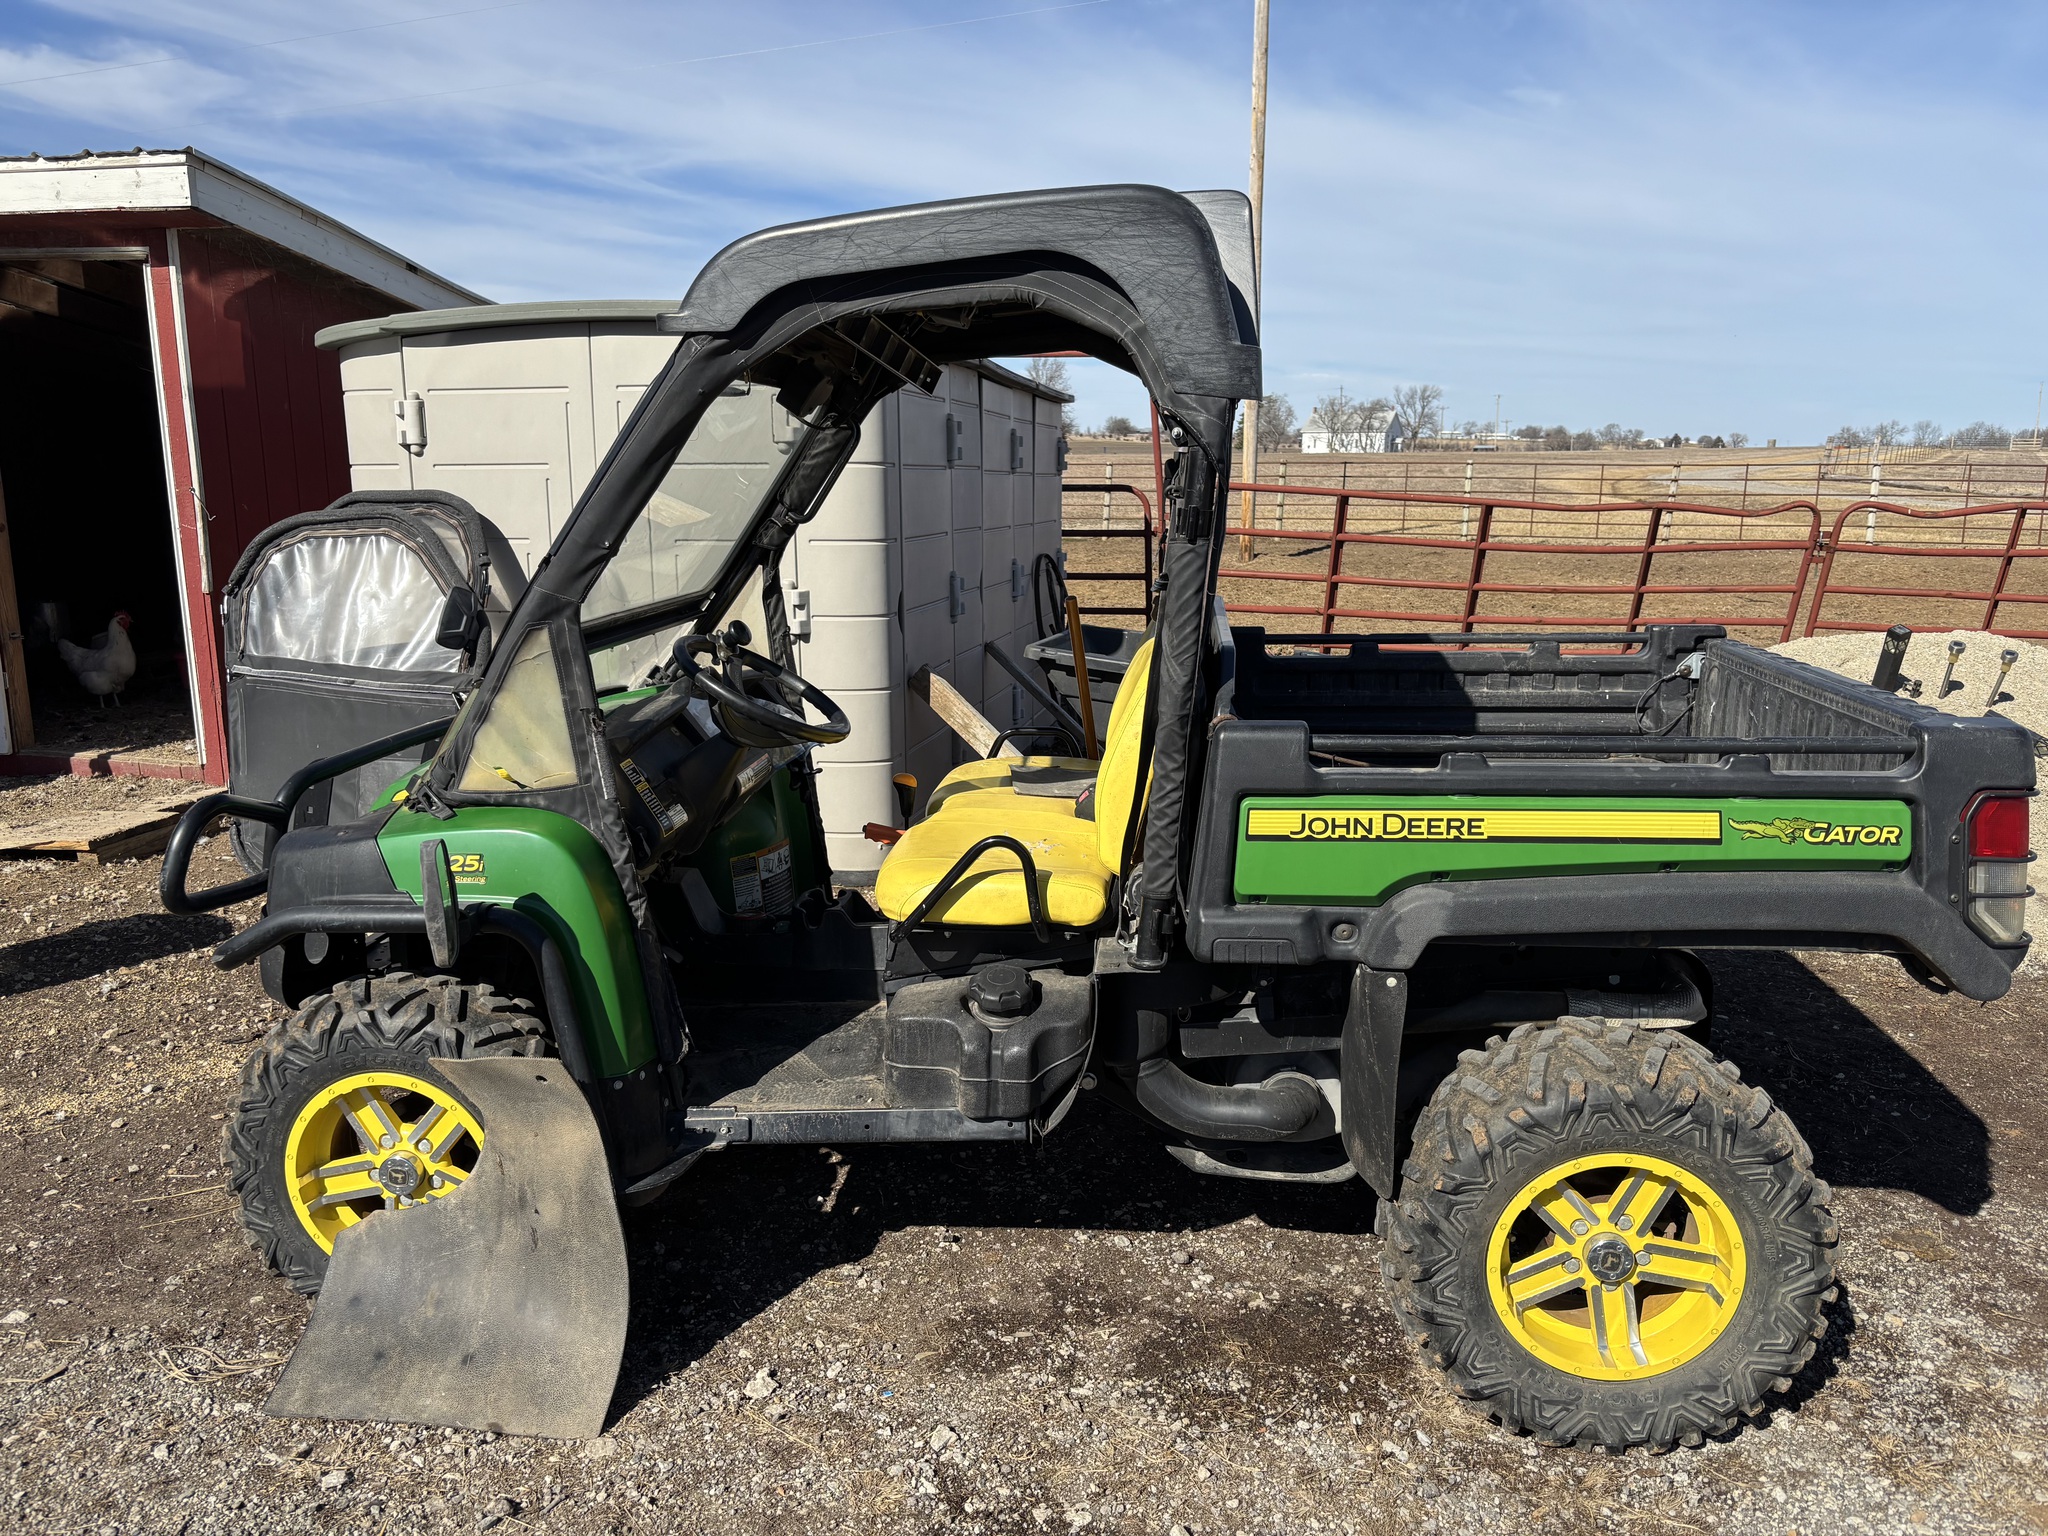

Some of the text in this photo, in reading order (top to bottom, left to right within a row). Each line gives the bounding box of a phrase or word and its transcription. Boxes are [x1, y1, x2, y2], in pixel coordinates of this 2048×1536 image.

[1289, 813, 1486, 837] JOHN DEERE
[1803, 822, 1903, 846] GATOR
[447, 854, 484, 872] 25i
[455, 875, 487, 885] Steering
[1719, 1342, 1748, 1371] RADIAL
